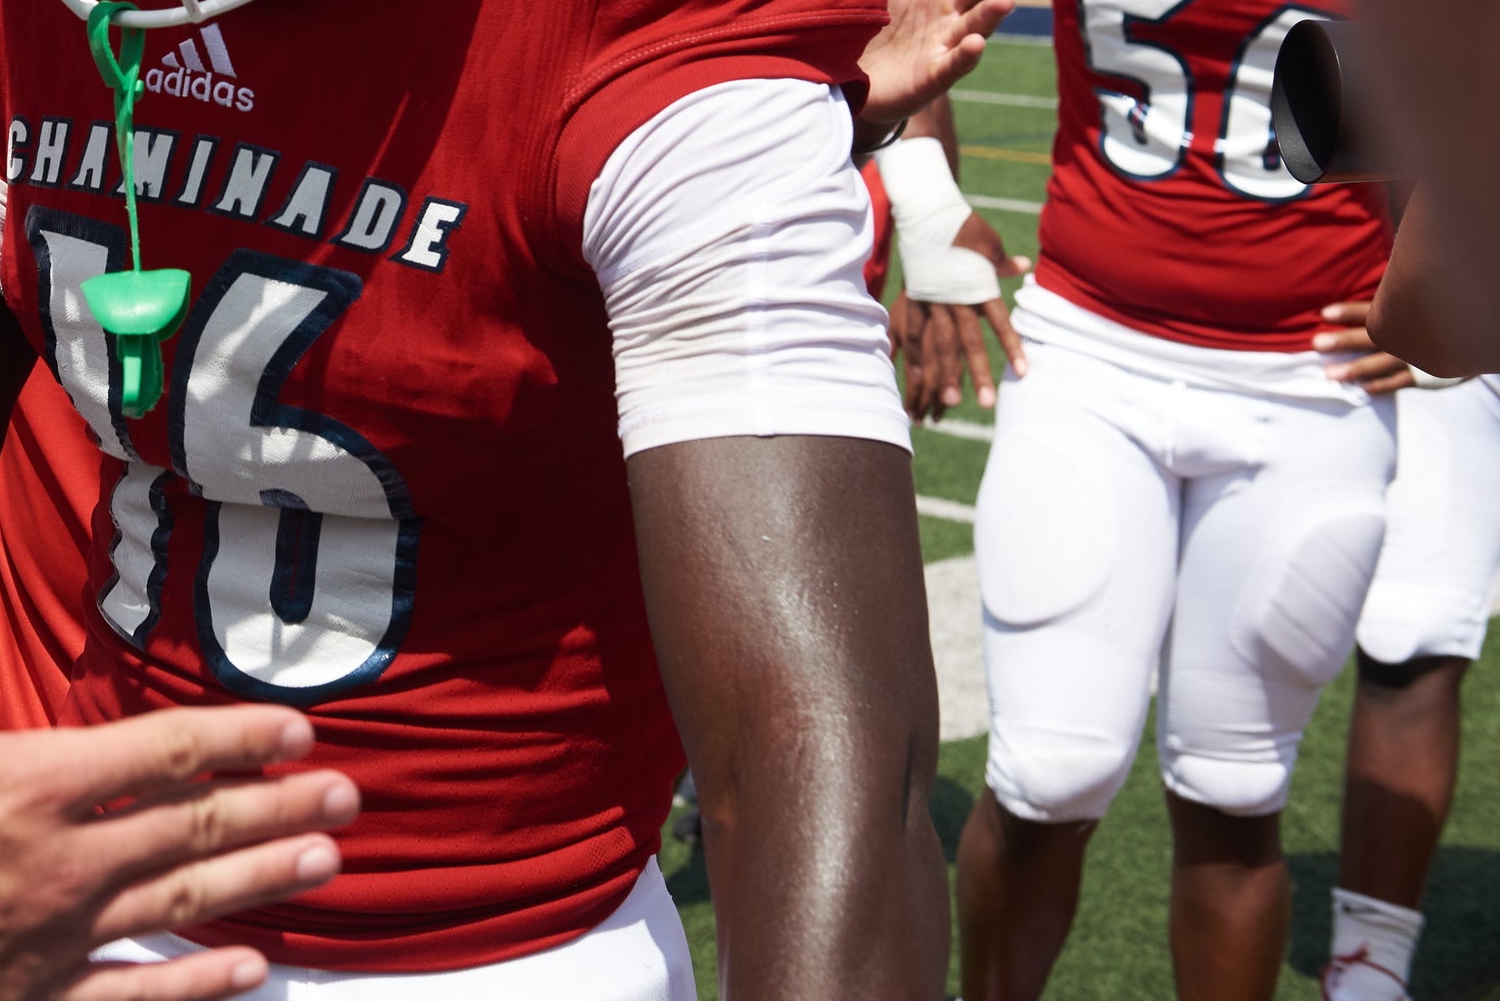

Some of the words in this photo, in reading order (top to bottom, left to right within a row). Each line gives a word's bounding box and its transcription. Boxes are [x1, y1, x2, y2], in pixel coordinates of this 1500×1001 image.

[145, 66, 255, 113] adidas
[6, 114, 470, 274] CHAMINADE
[24, 204, 421, 702] 16
